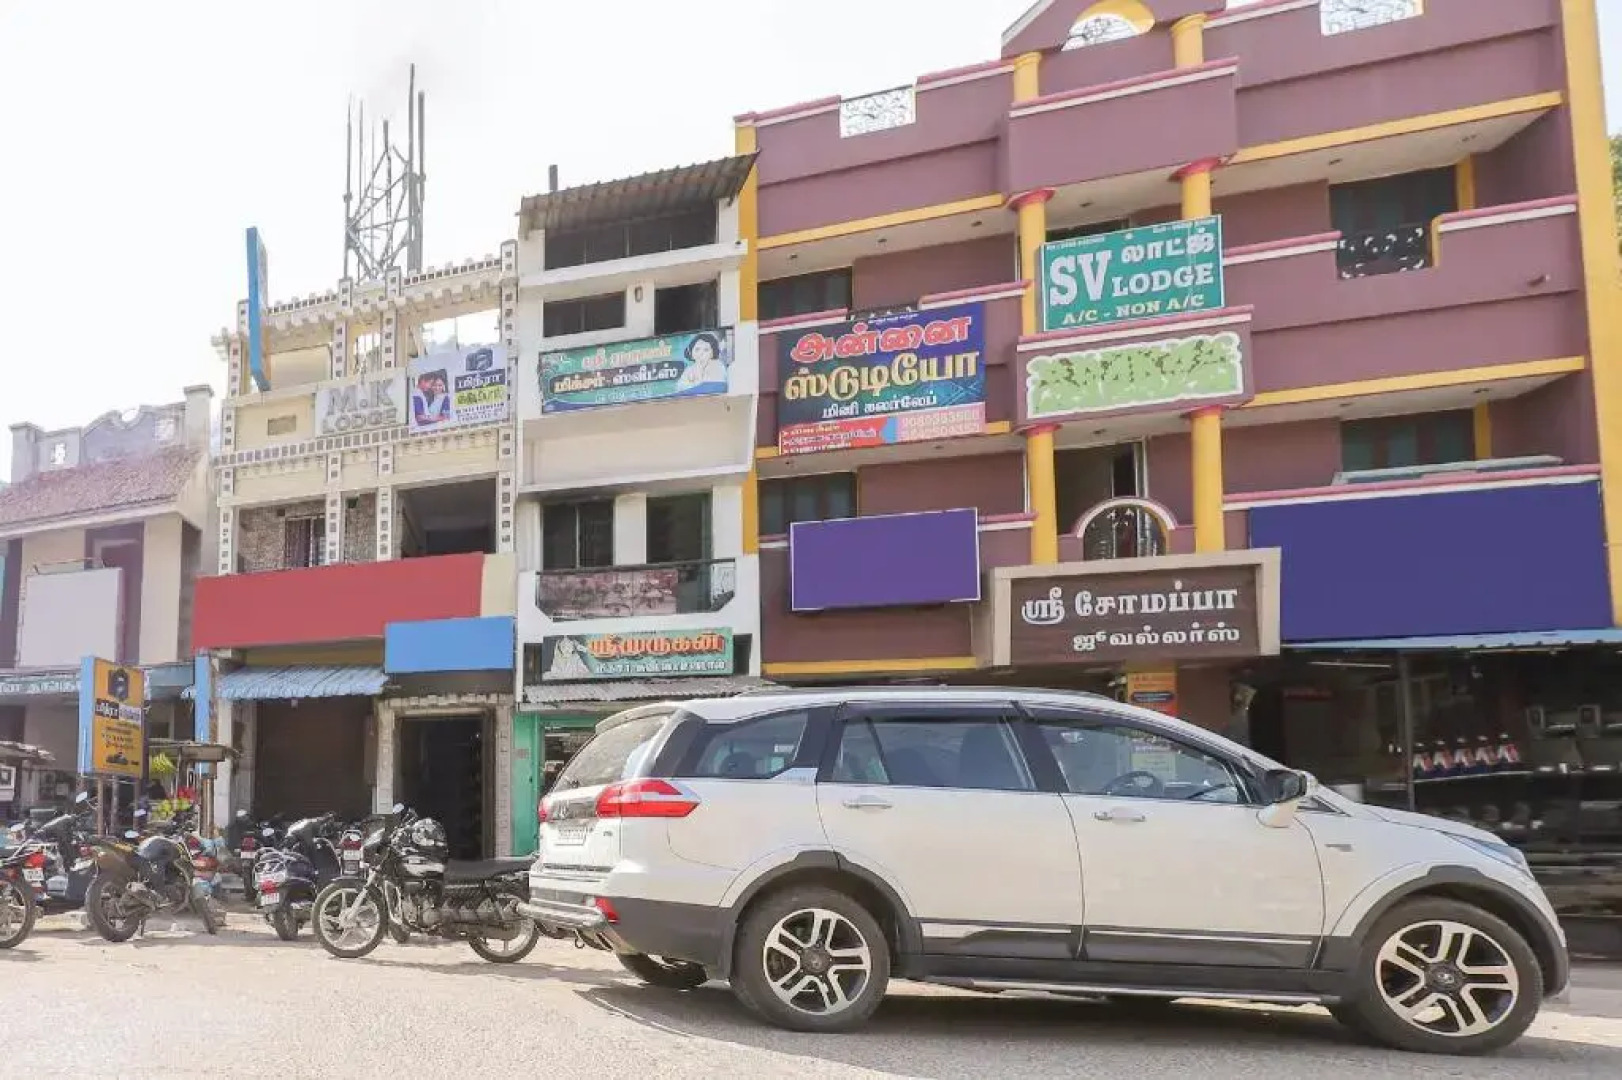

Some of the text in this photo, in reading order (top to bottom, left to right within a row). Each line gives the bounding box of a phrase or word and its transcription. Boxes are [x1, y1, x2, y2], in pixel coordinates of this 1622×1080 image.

[1050, 250, 1214, 306] SV LODGE
[1062, 309, 1098, 325] A/C
[1116, 300, 1161, 318] NON
[1166, 294, 1205, 311] A/C
[790, 316, 972, 363] அன்னை
[785, 352, 979, 402] ஸ்டுடியோ
[323, 407, 397, 434] LODGE
[1075, 580, 1238, 617] சோமப்பா
